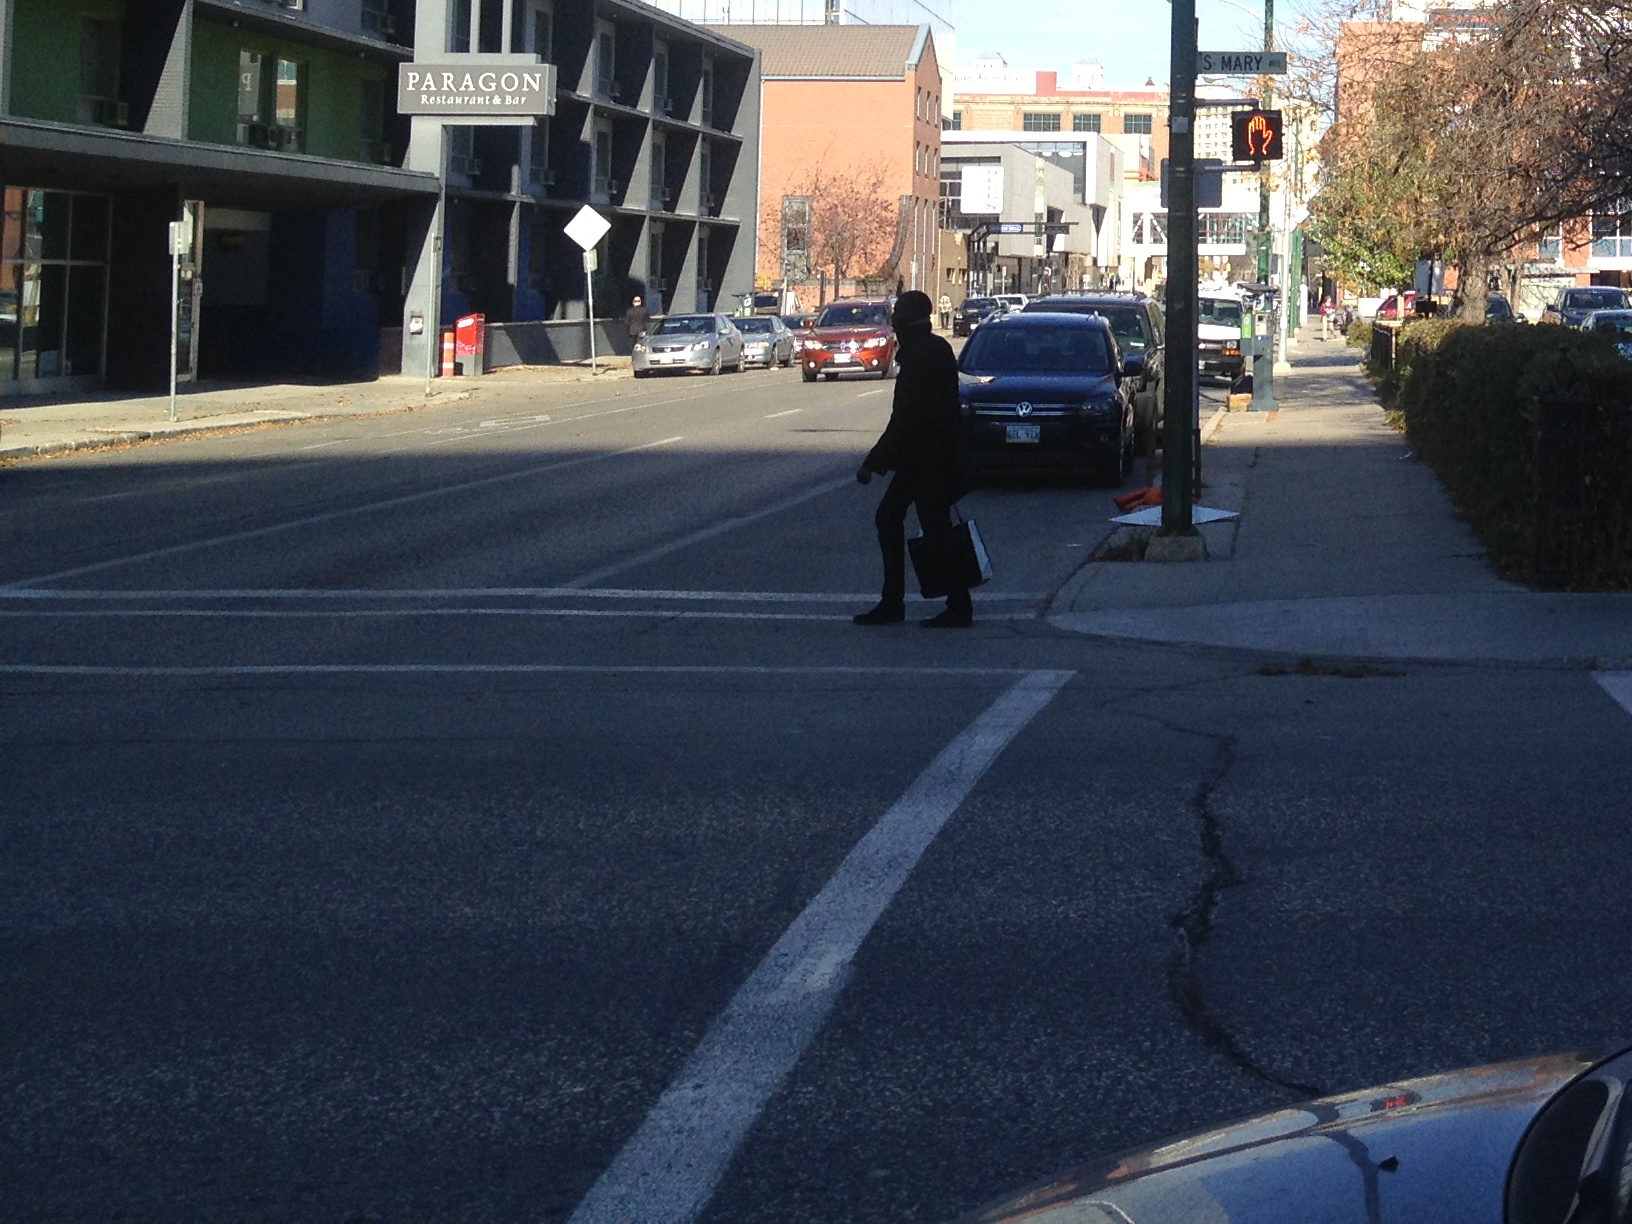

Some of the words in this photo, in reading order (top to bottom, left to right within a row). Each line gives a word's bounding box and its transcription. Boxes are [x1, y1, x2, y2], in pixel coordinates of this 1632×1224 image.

[1221, 55, 1263, 71] MARY
[406, 72, 541, 92] PARAGON
[420, 94, 491, 105] Restaurant
[492, 95, 502, 105] &
[505, 95, 527, 105] Bar
